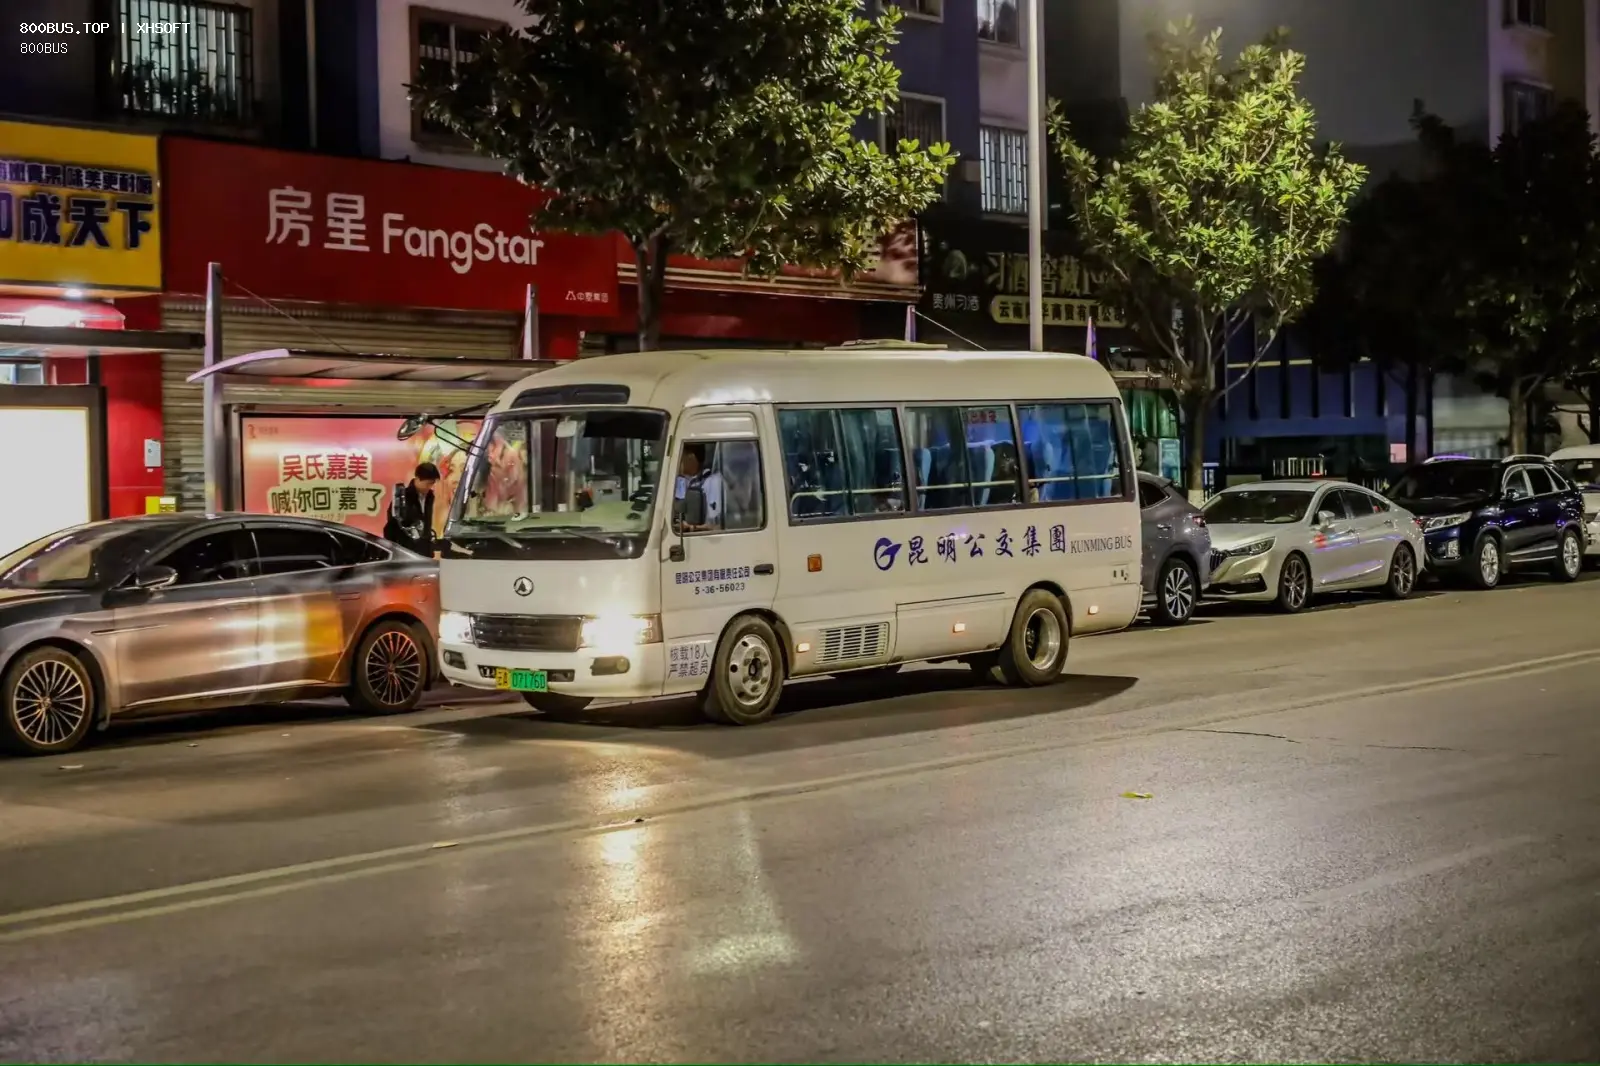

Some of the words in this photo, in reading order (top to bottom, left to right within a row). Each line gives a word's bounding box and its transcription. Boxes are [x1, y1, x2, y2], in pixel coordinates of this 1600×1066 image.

[265, 186, 370, 252] 房星
[382, 212, 544, 274] FangStar
[932, 293, 980, 311] 贵州习酒
[282, 453, 368, 482] 吴氏嘉美
[907, 524, 1066, 566] 昆明公交集團
[1070, 537, 1113, 554] KUNMING
[1114, 535, 1132, 550] BUS
[668, 660, 708, 680] 严禁超员
